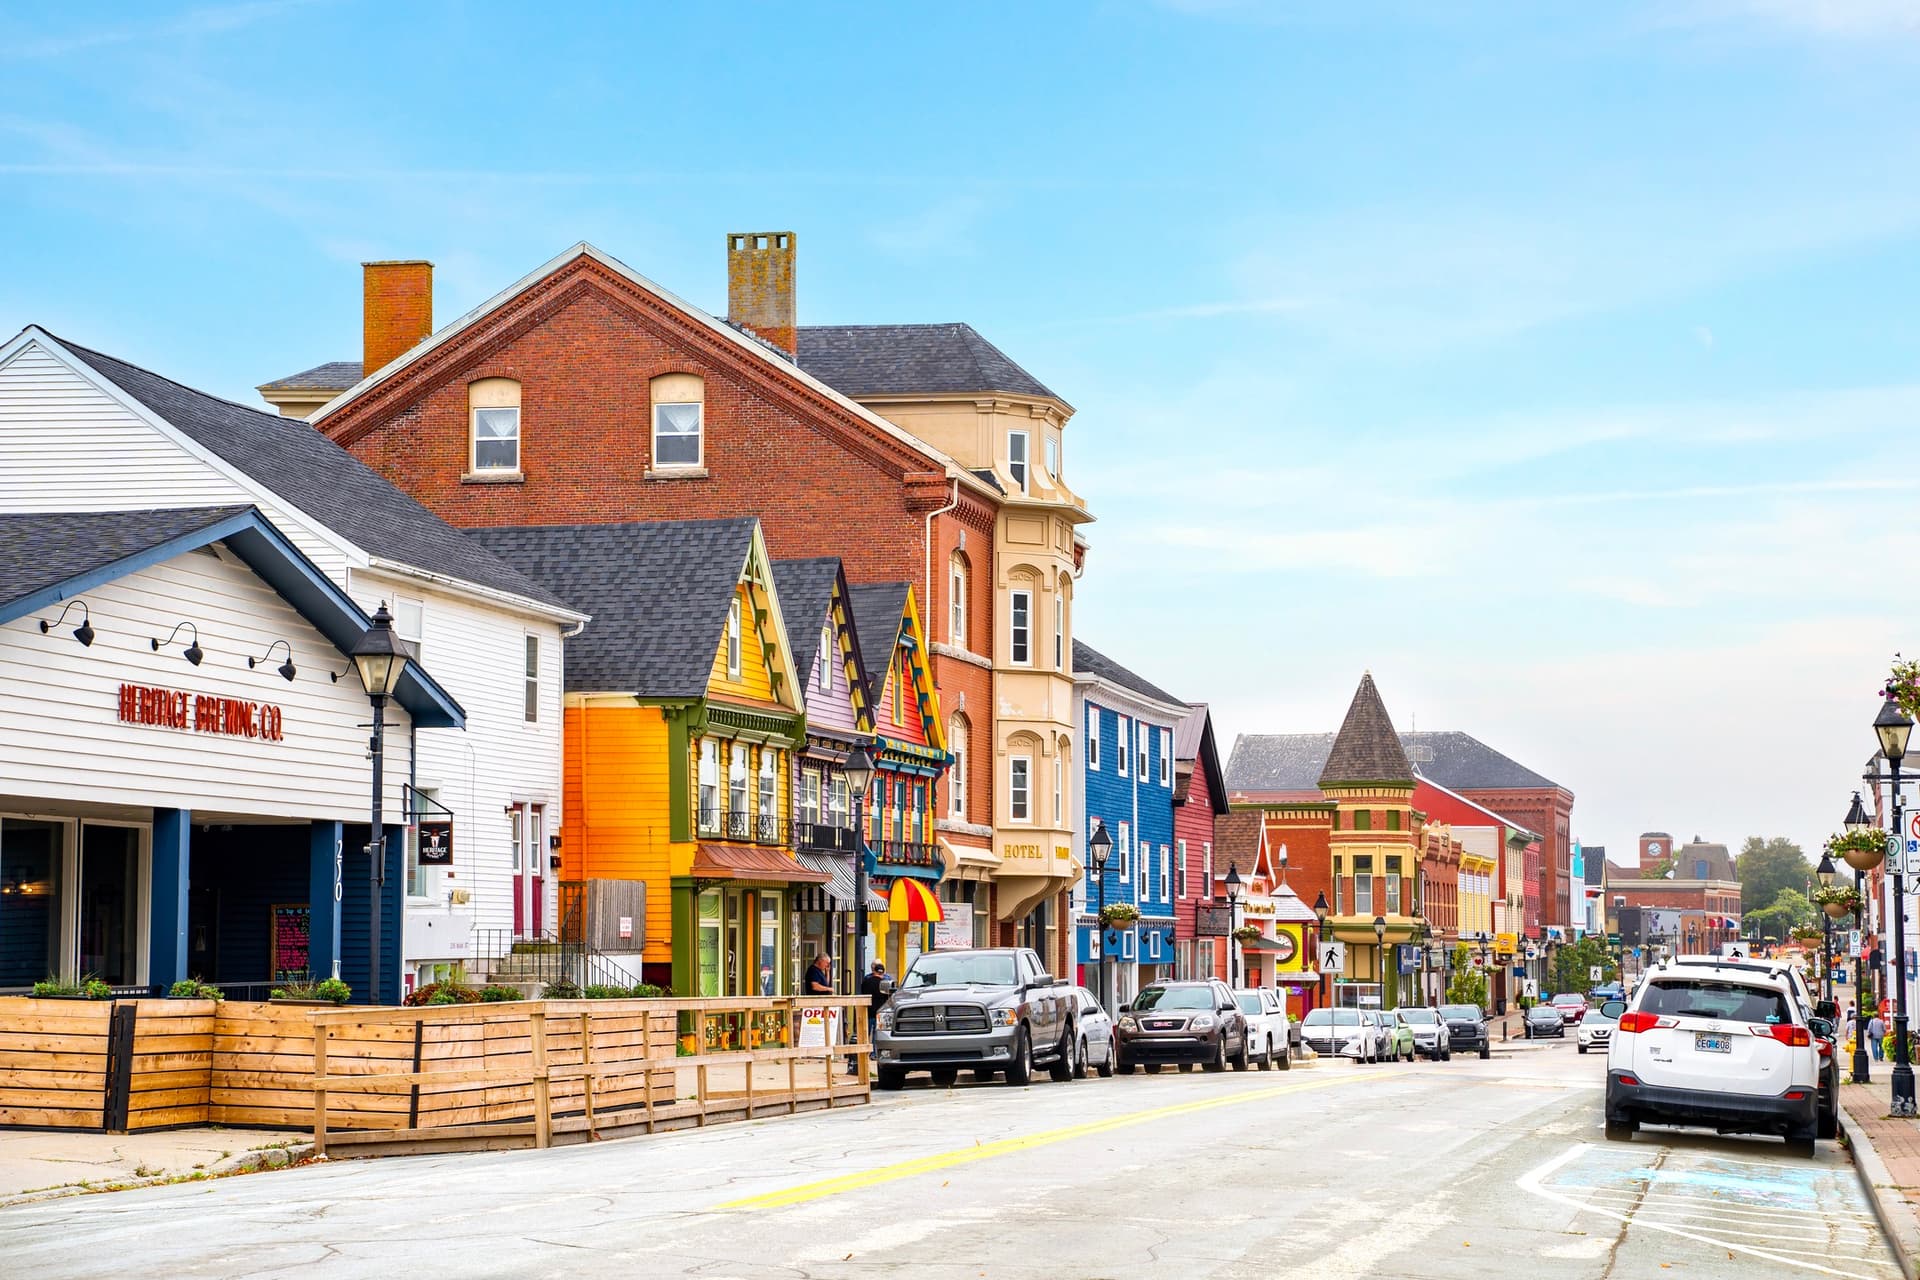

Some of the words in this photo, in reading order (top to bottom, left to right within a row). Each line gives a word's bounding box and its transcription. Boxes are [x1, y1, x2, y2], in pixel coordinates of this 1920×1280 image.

[119, 683, 192, 729] HERITAGE
[195, 694, 258, 738] BREWING
[260, 703, 284, 741] CO.
[1003, 844, 1042, 859] HOTEL
